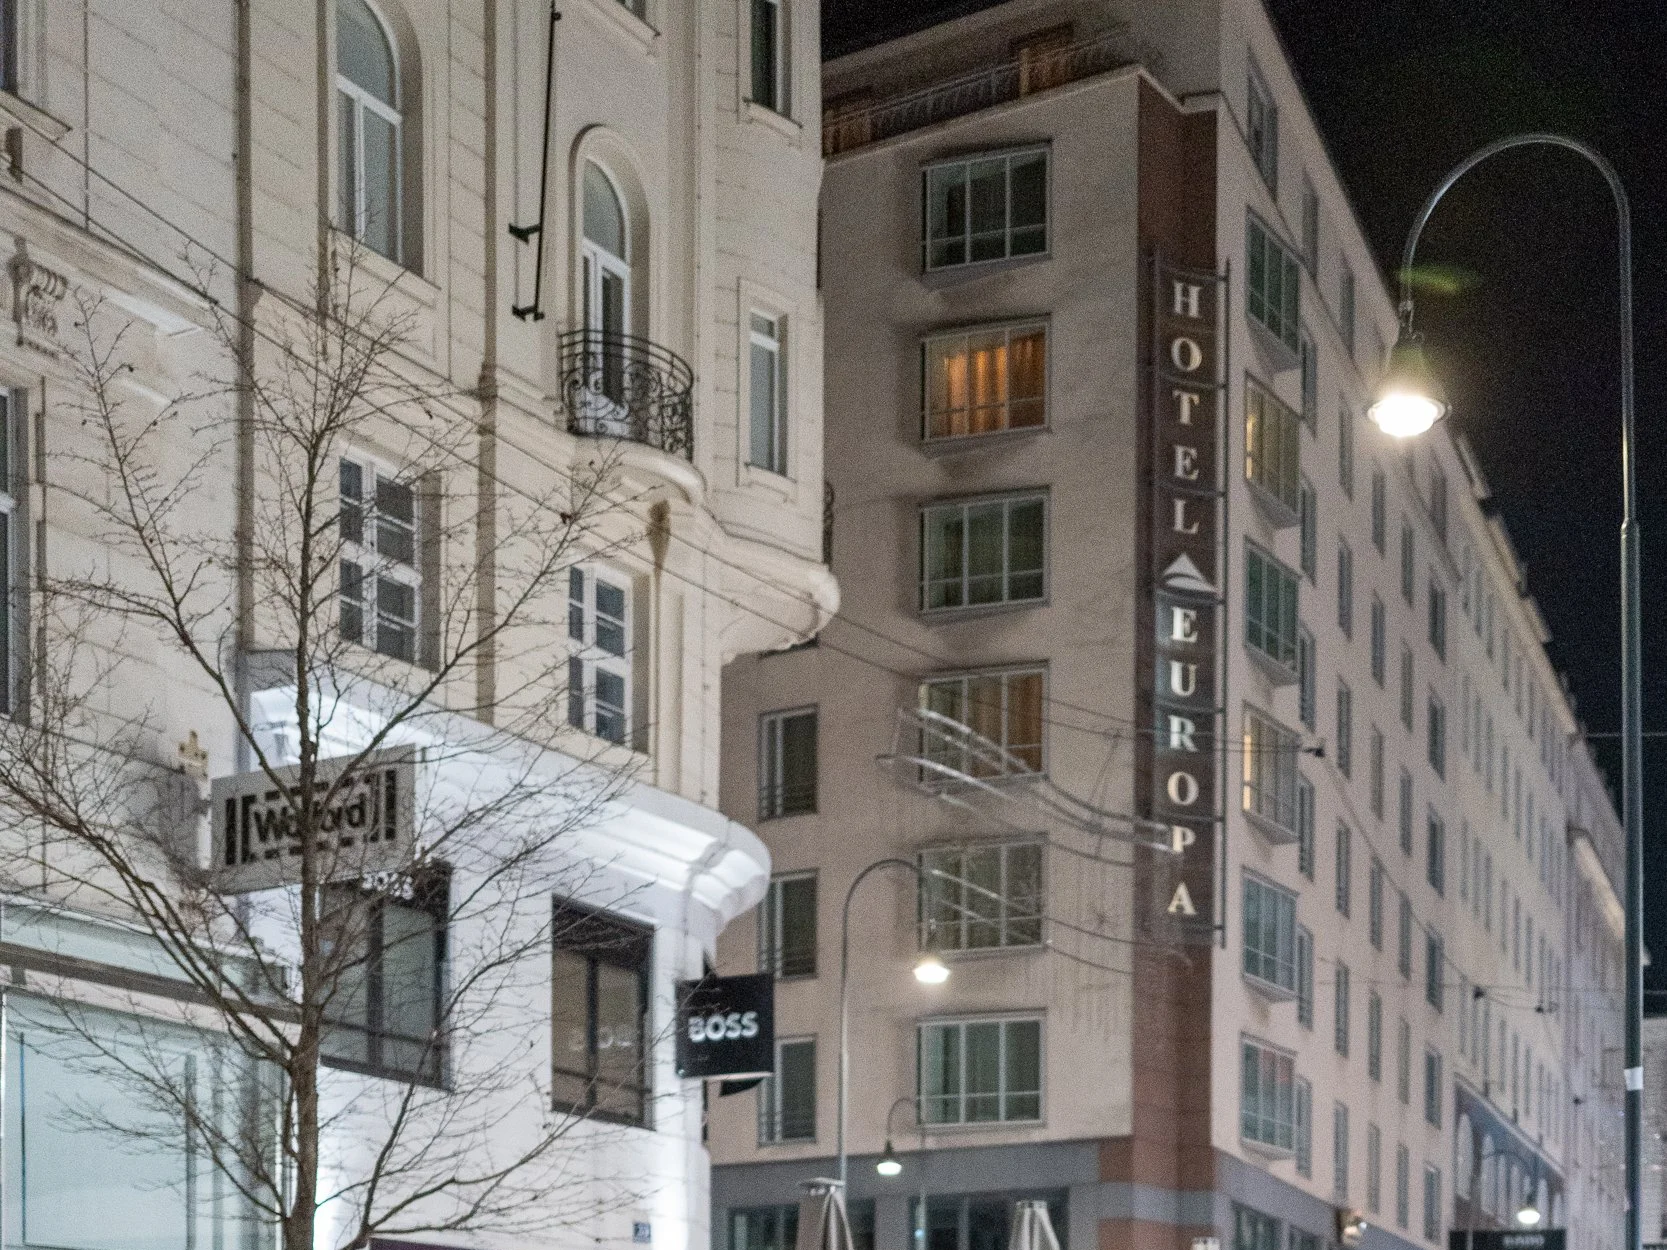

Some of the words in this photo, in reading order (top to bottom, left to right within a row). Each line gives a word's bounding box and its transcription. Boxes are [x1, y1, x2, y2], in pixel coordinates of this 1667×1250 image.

[1171, 281, 1202, 535] HOTEL
[254, 792, 367, 843] Woford
[1166, 605, 1199, 917] EUROPA
[688, 1011, 760, 1043] BOSS
